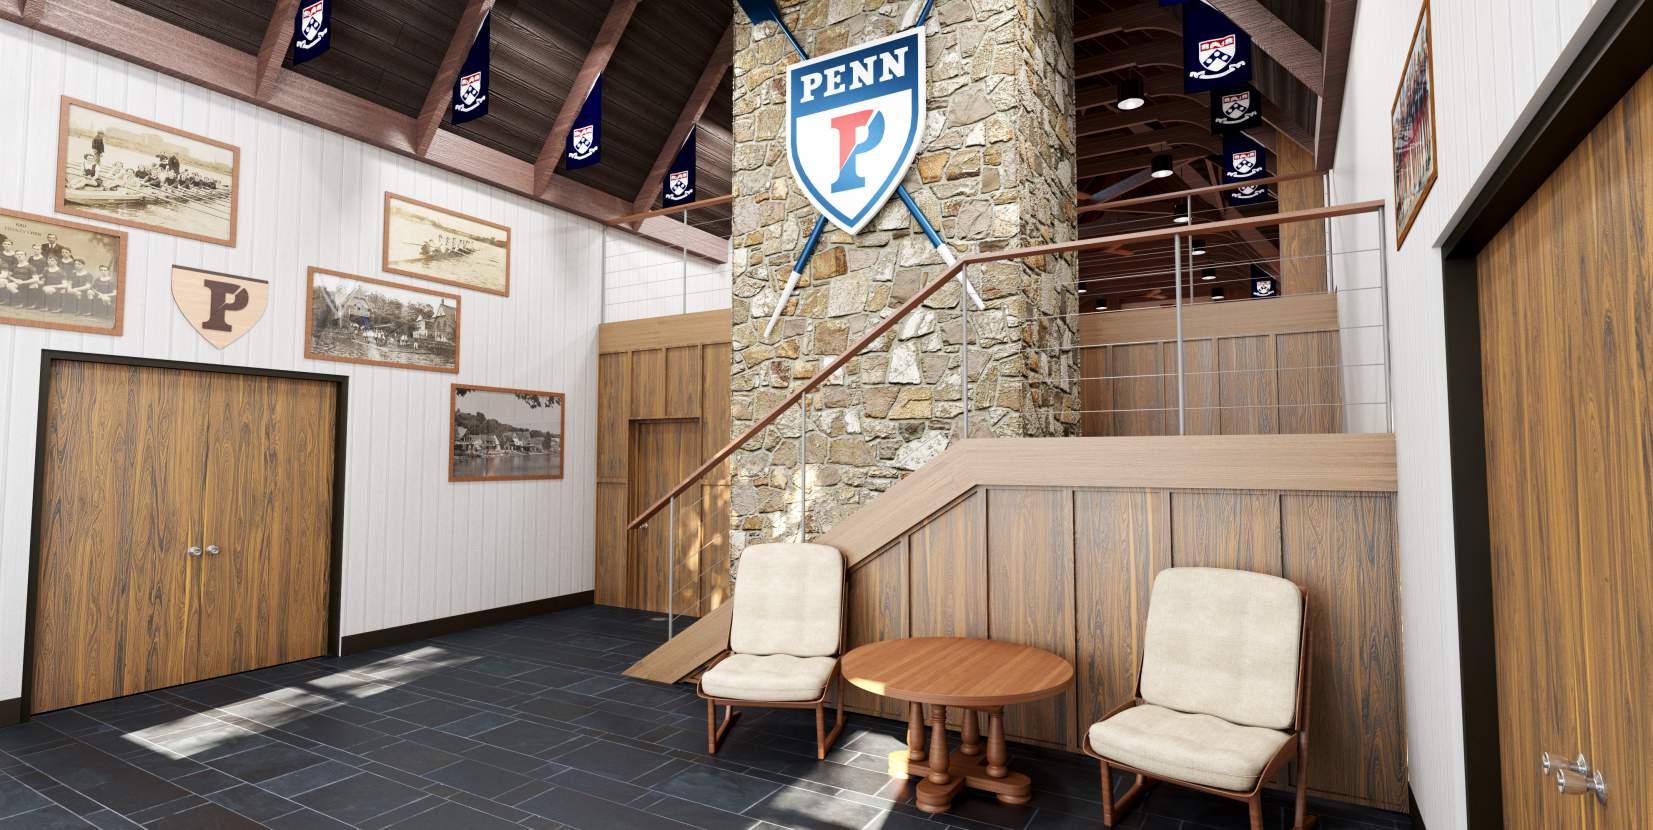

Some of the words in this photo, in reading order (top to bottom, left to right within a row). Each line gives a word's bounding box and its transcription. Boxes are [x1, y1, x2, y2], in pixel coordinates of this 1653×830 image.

[800, 46, 908, 103] PENN
[831, 109, 885, 193] P
[202, 279, 249, 332] P
